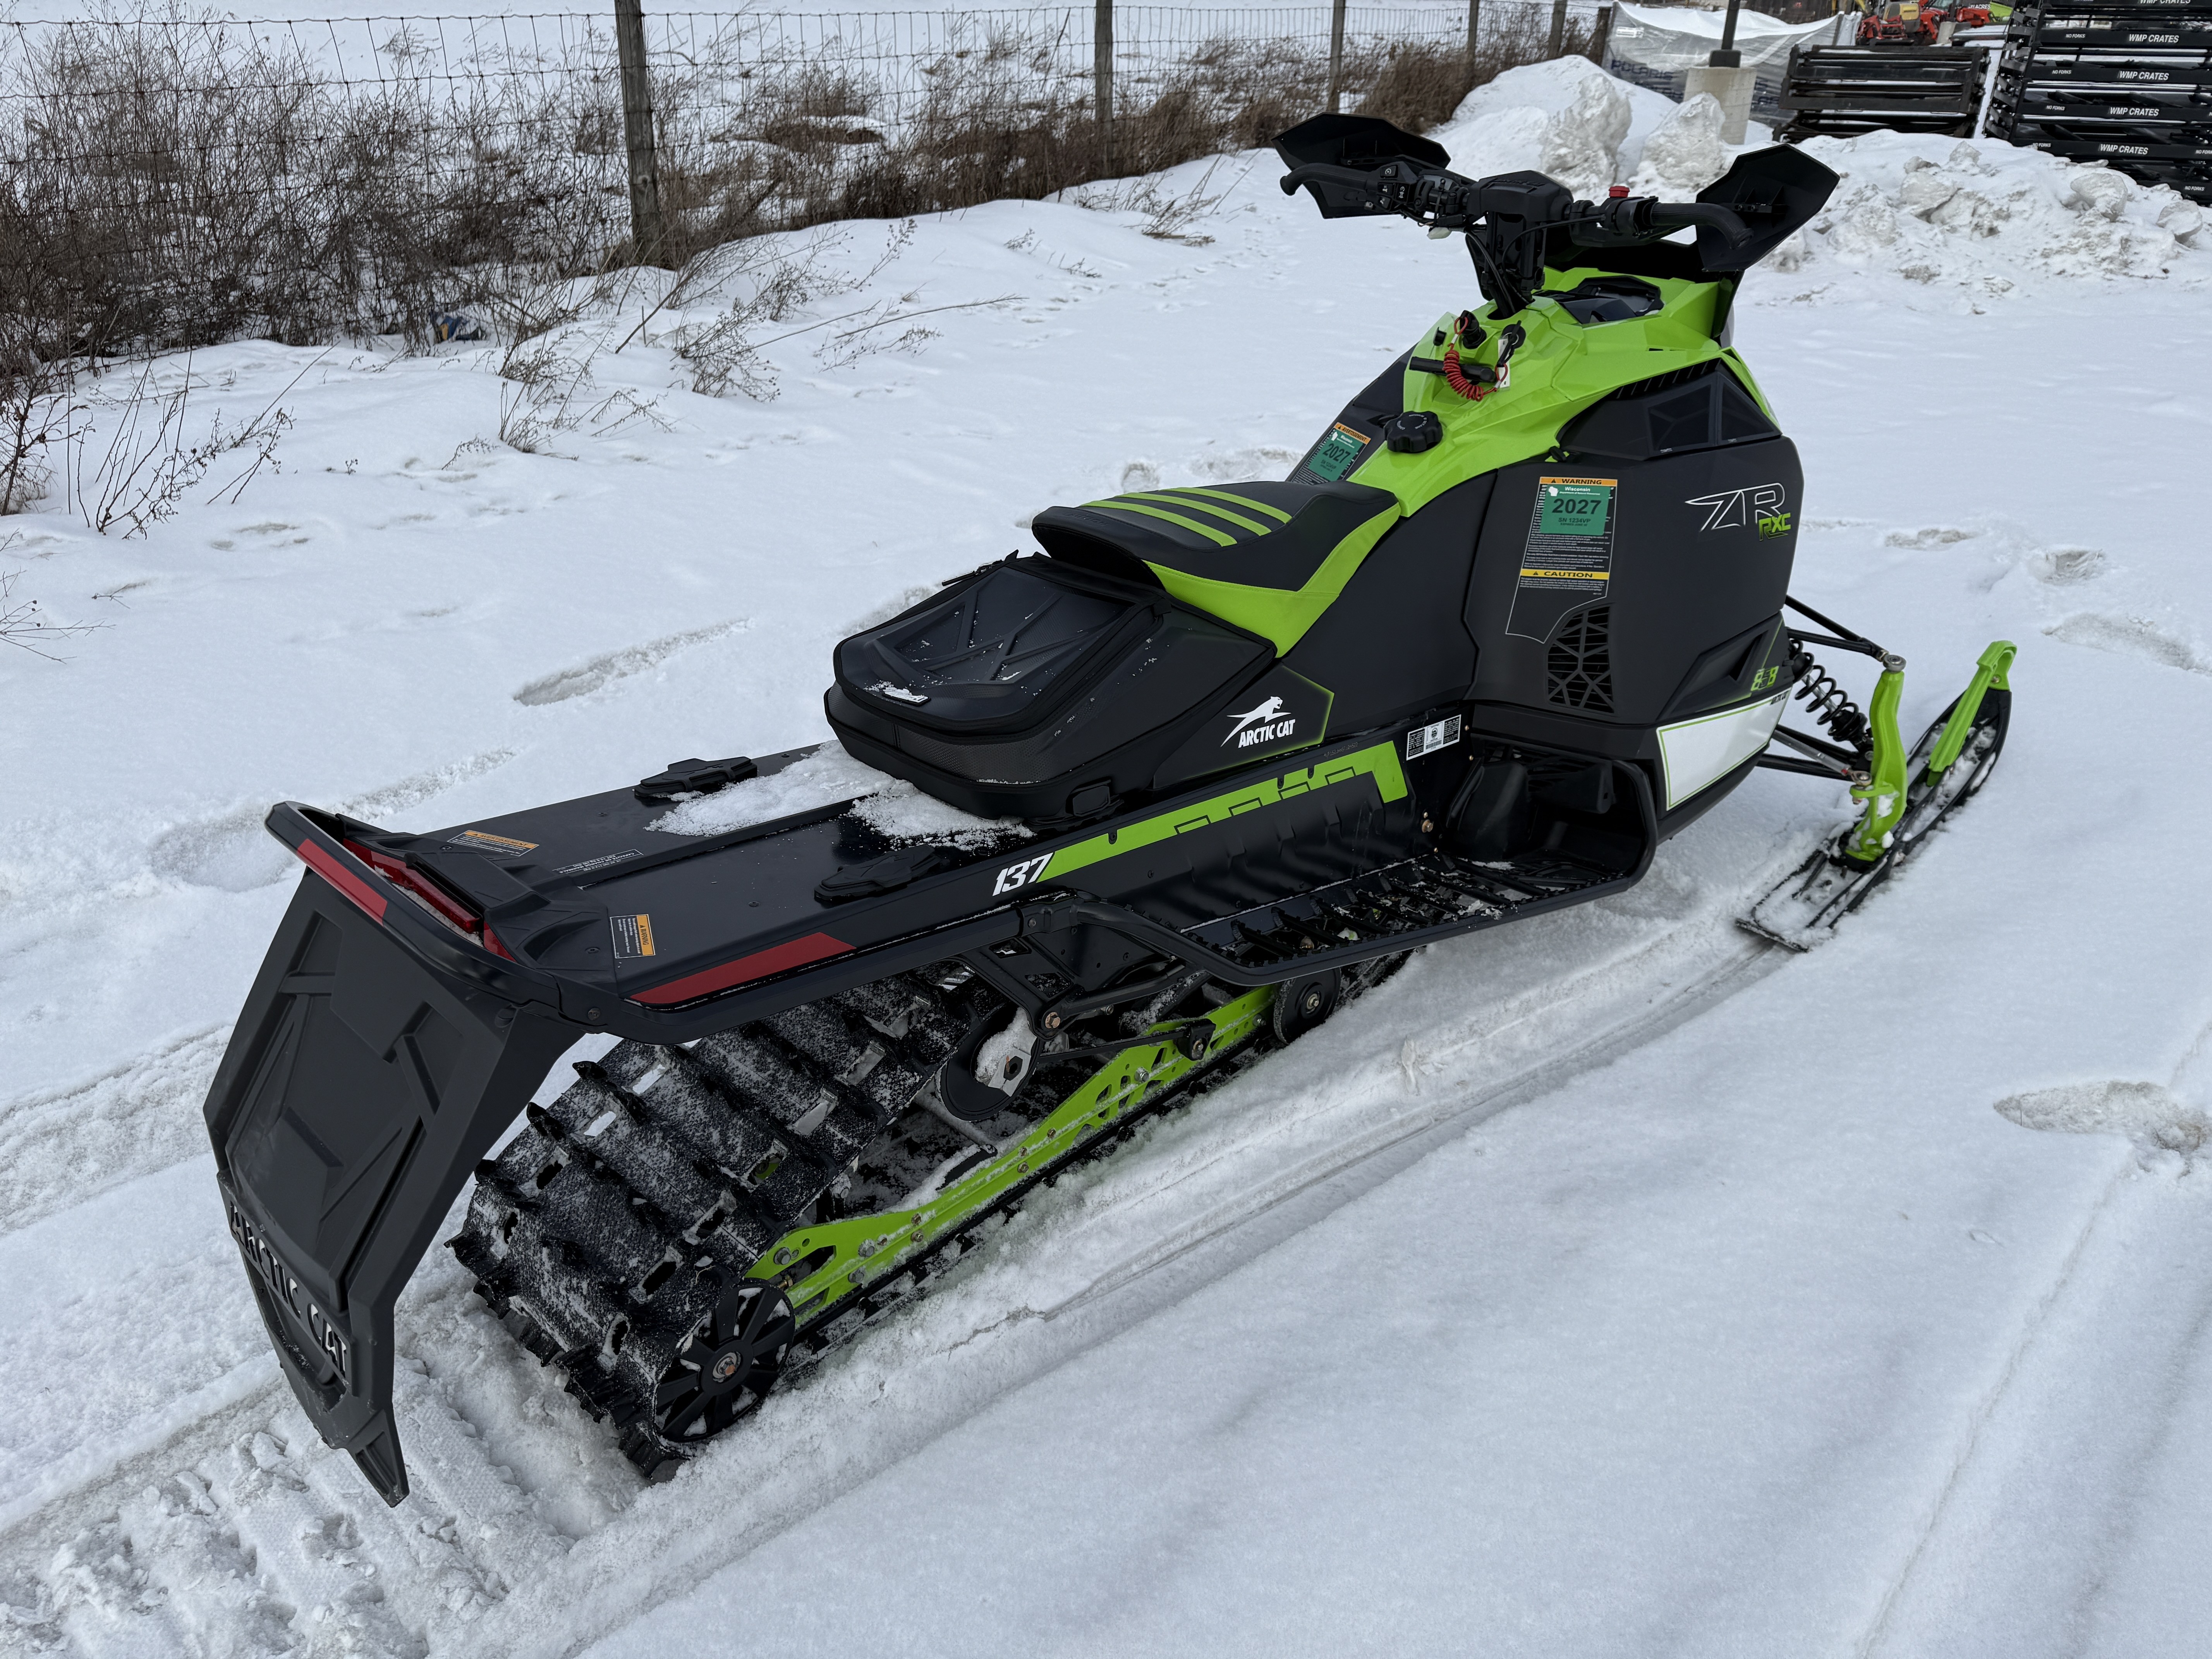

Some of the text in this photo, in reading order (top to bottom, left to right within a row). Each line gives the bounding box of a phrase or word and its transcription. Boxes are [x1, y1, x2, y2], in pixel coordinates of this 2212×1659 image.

[2148, 35, 2179, 43] CRATES
[2119, 71, 2169, 80] WMP CRATES
[2110, 107, 2159, 116] WMP CRATES
[2100, 144, 2148, 155] WMP CRATES
[1322, 443, 1351, 464] 2027
[1552, 498, 1601, 514] 2027
[1759, 512, 1791, 541] RXC
[1238, 719, 1295, 748] ARCTIC CAT
[993, 852, 1054, 896] 137
[641, 928, 649, 945] WARNING
[230, 1201, 347, 1377] ARCTIC CAT
